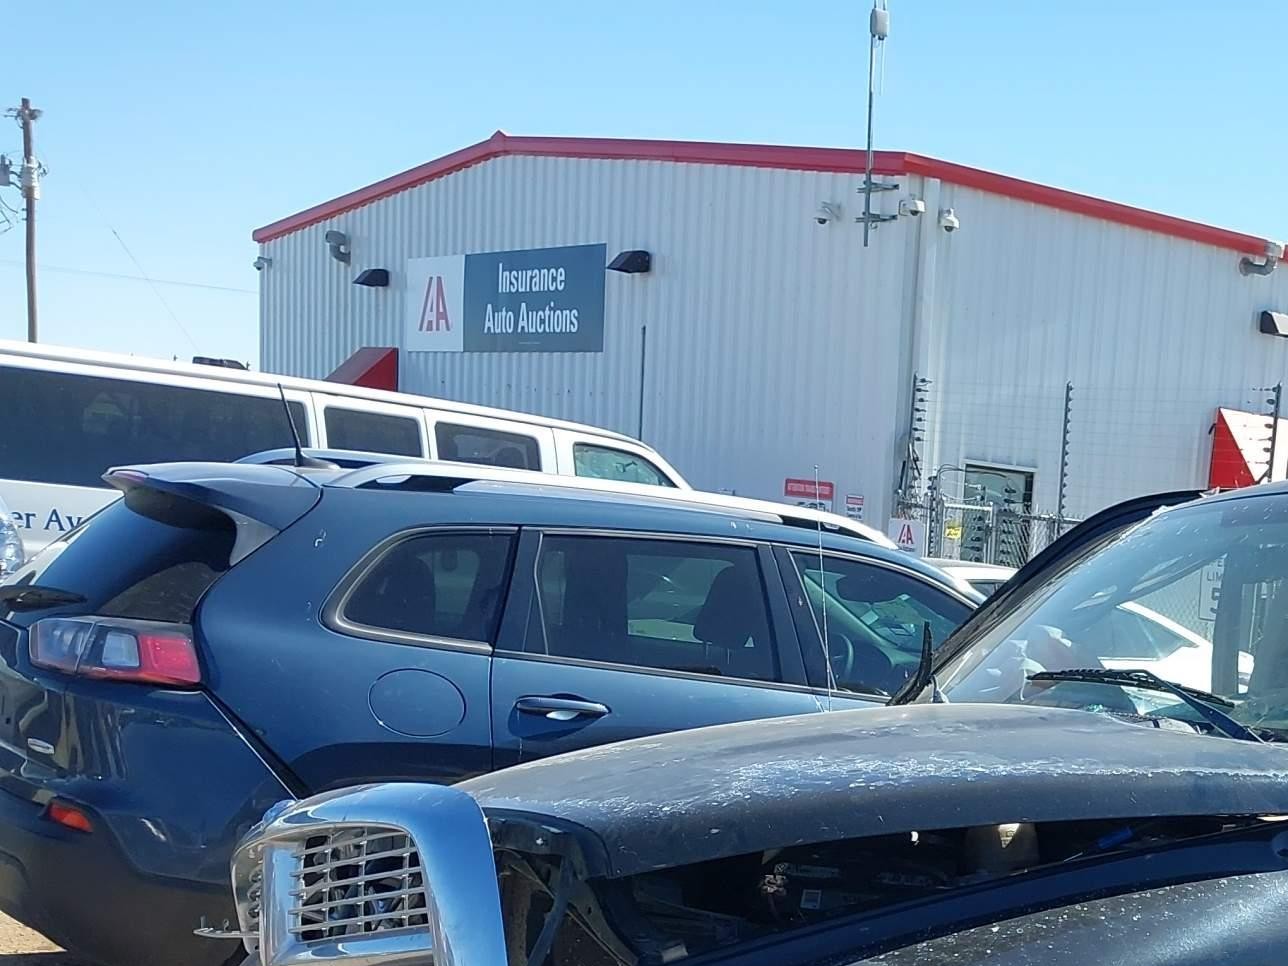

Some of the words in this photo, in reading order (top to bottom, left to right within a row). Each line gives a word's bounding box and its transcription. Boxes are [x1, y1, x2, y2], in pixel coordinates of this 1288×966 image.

[498, 262, 566, 293] Insurance
[484, 303, 514, 334] Auto
[517, 301, 579, 334] Auctions
